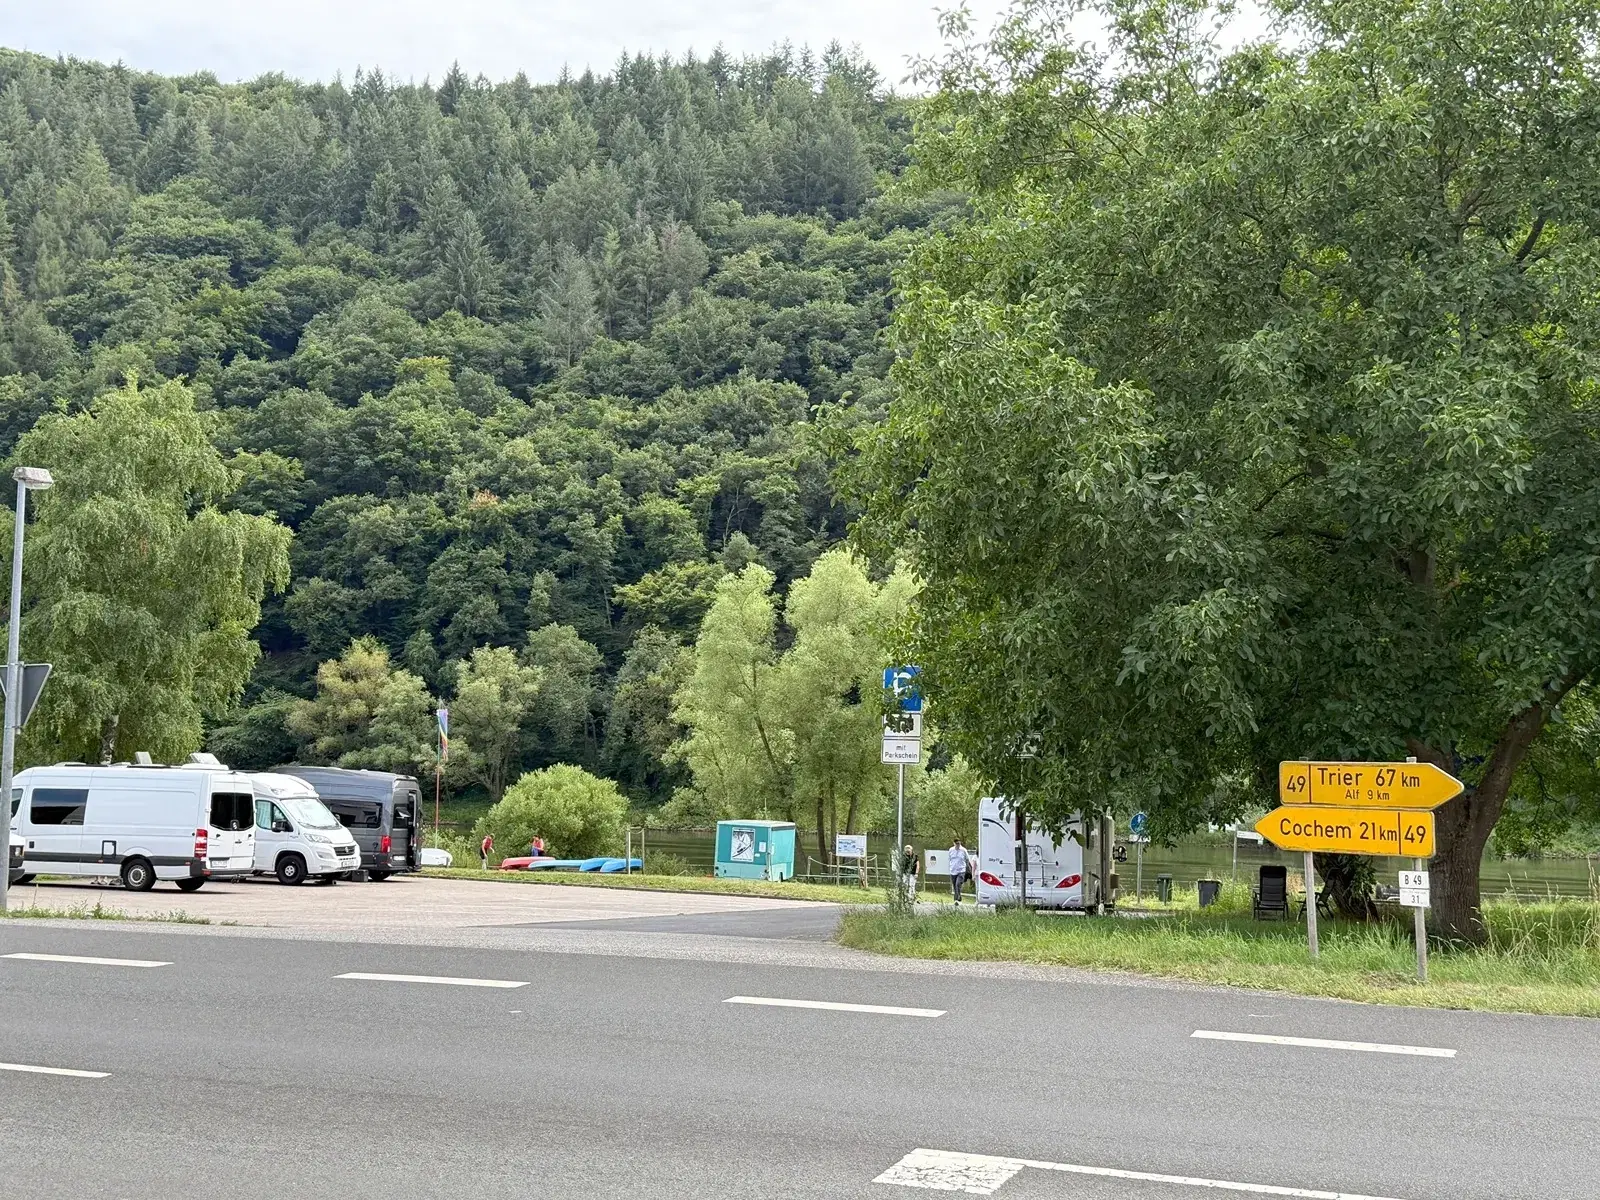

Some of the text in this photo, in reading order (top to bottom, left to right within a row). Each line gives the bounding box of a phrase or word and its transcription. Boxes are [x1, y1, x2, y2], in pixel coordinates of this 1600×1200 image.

[884, 751, 918, 759] Parkschein
[1286, 775, 1306, 793] 49
[1317, 768, 1420, 788] Trier 67 km
[1345, 789, 1390, 800] Alf 9 km
[1280, 817, 1397, 842] Cochem 21 km
[1404, 825, 1426, 844] 49
[1404, 874, 1422, 886] B 49
